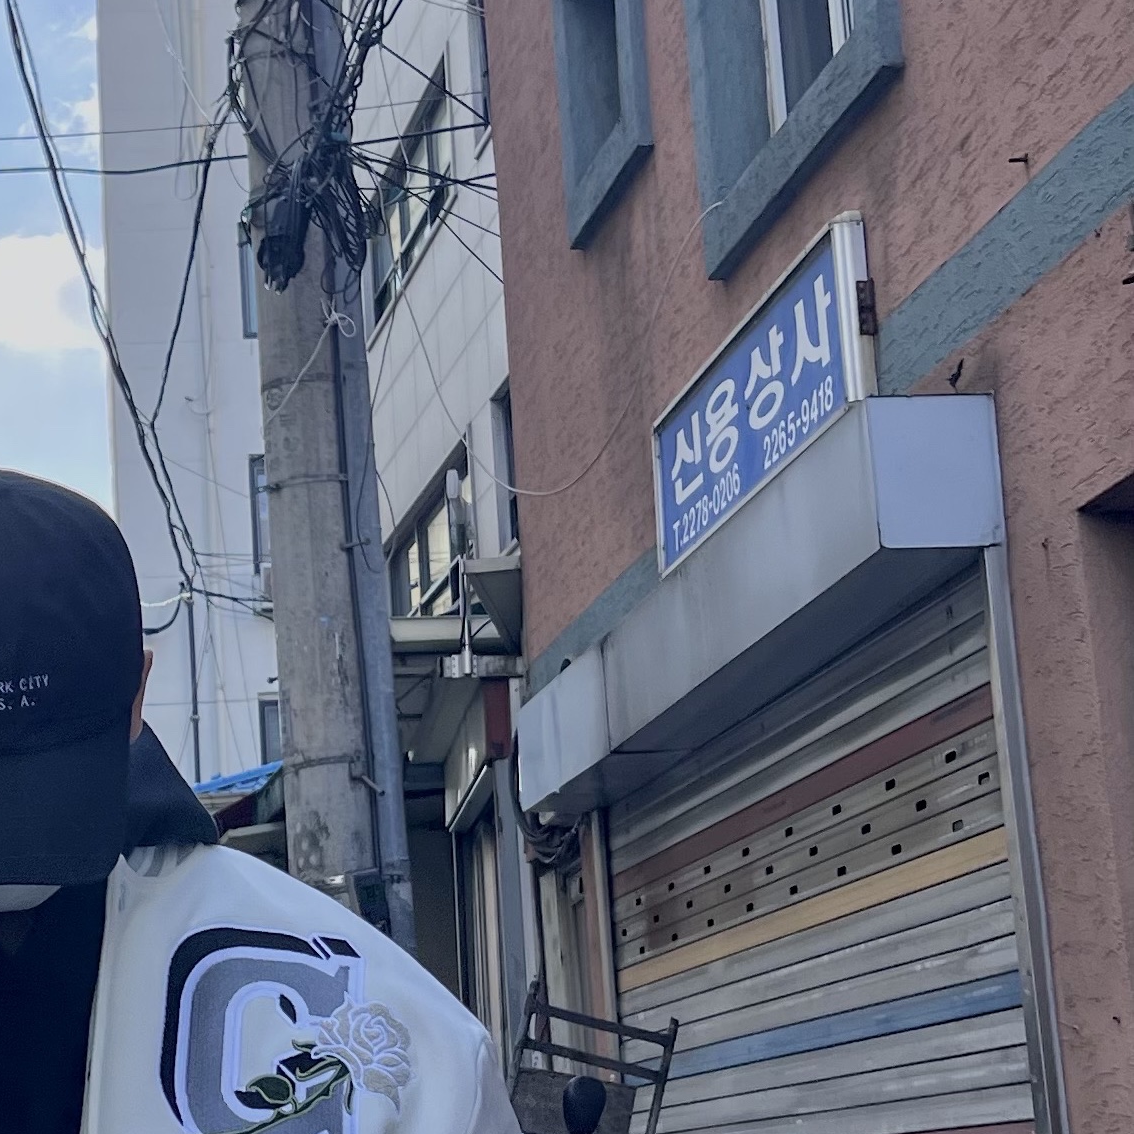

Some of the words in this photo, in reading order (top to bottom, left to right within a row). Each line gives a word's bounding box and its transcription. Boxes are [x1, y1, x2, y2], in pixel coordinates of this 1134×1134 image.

[671, 273, 832, 506] 신용상사
[763, 375, 834, 470] 2265-9418
[19, 674, 49, 691] CITY
